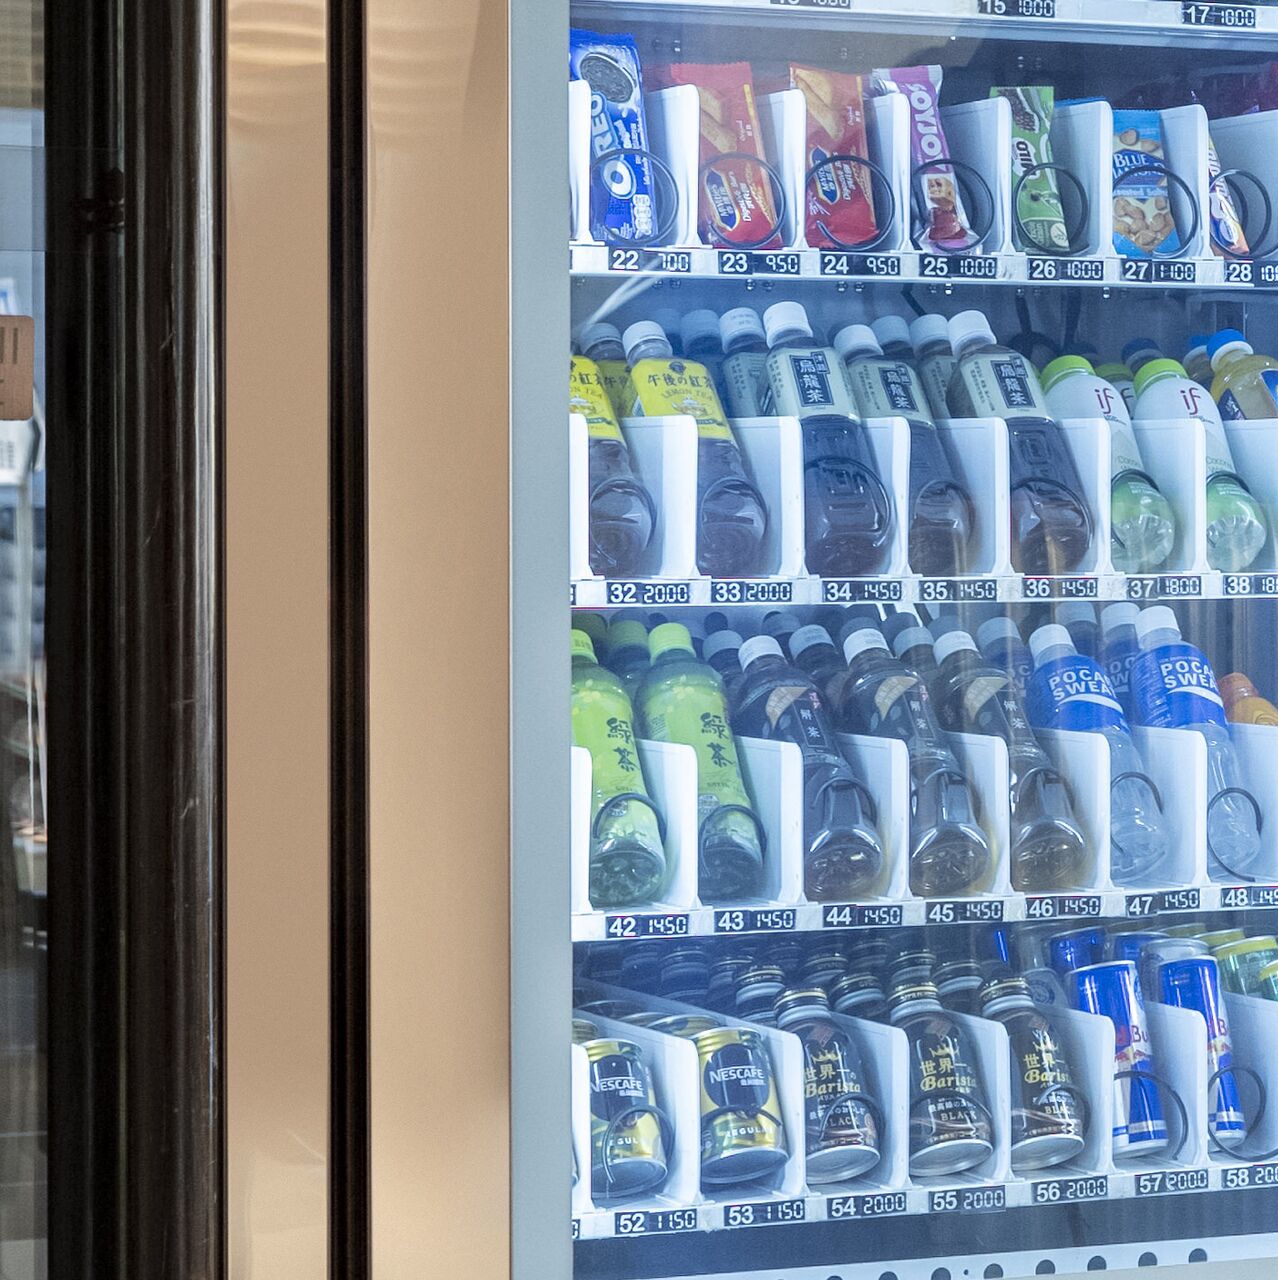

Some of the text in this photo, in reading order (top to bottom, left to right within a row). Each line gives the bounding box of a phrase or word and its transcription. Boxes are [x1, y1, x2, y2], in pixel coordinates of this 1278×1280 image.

[1186, 6, 1205, 23] 17
[592, 92, 636, 199] OREO
[1113, 153, 1149, 168] BLUE
[612, 251, 638, 270] 22
[723, 253, 747, 271] 23
[824, 255, 849, 274] 24
[925, 259, 947, 276] 25
[1032, 261, 1056, 279] 26
[1125, 262, 1147, 279] 27
[1230, 265, 1251, 281] 28
[799, 360, 826, 403] 烏龍茶
[886, 369, 910, 410] 烏龍茶
[1000, 360, 1027, 406] 烏龍茶
[1094, 387, 1114, 415] if
[1180, 387, 1201, 415] if
[611, 584, 636, 603] 32
[716, 583, 740, 601] 33
[827, 584, 851, 600] 34
[924, 583, 947, 600] 35
[1026, 579, 1049, 596] 36
[1131, 580, 1154, 597] 37
[1228, 577, 1249, 593] 38
[1128, 897, 1153, 915] 47
[1225, 890, 1249, 906] 48
[826, 907, 852, 925] 44
[930, 904, 954, 922] 45
[1029, 899, 1053, 917] 46
[609, 917, 636, 936] 42
[719, 912, 744, 929] 43
[805, 1080, 861, 1098] Barista
[920, 1075, 977, 1091] Barista
[941, 1110, 977, 1122] BLACK
[1139, 1175, 1163, 1192] 57
[1226, 1170, 1249, 1187] 58
[934, 1192, 956, 1209] 55
[1037, 1183, 1060, 1201] 56
[729, 1207, 753, 1224] 53
[832, 1199, 856, 1216] 54
[620, 1214, 644, 1232] 52
